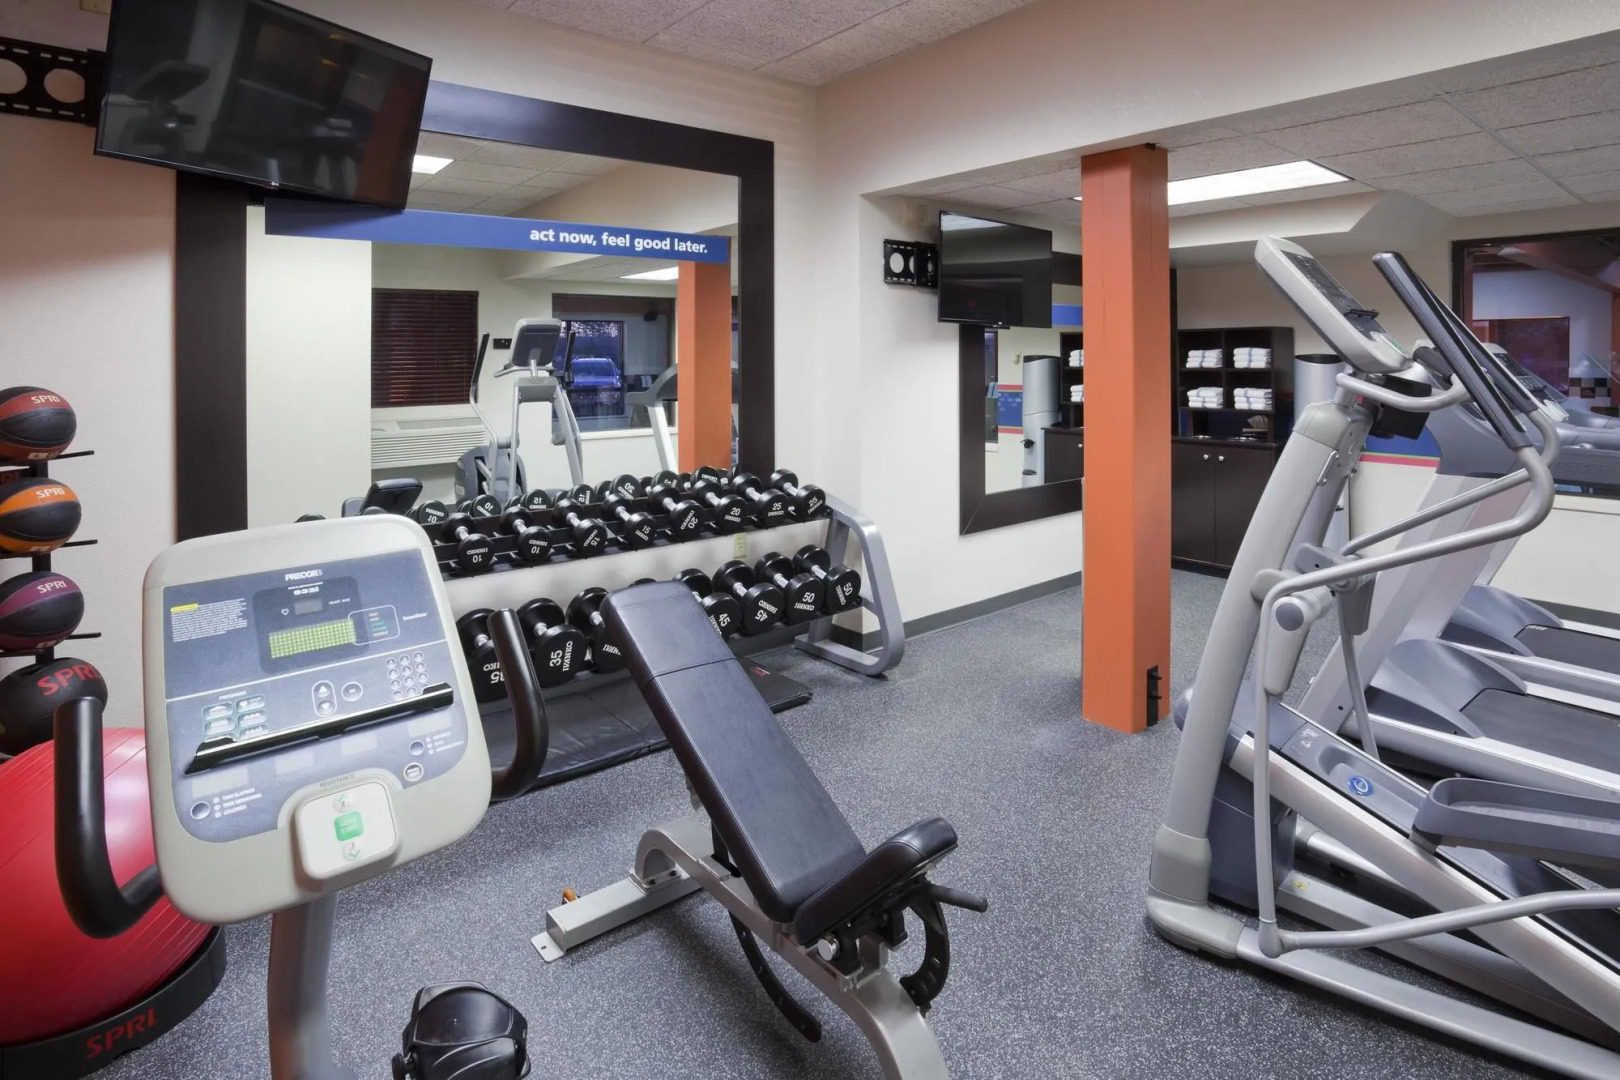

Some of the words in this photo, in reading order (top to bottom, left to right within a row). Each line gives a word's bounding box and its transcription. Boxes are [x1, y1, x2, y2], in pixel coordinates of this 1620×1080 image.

[530, 229, 555, 241] act
[559, 232, 597, 246] now,
[602, 232, 630, 247] feel
[634, 236, 670, 251] good
[674, 239, 708, 253] later.
[31, 395, 61, 404] SPRI
[36, 487, 66, 498] SPRI
[772, 502, 782, 511] 25
[808, 497, 818, 507] 25
[730, 507, 741, 516] 20
[687, 518, 698, 529] 20
[642, 525, 651, 534] 15
[590, 537, 600, 547] 15
[531, 546, 540, 554] 10
[472, 555, 482, 563] 10
[285, 570, 318, 581] PRECOR
[37, 580, 67, 594] SPRI
[843, 582, 853, 596] 50
[802, 592, 815, 603] 50
[758, 600, 778, 614] IVANKO
[718, 613, 731, 627] 45
[755, 610, 768, 622] 45
[550, 650, 563, 667] 35
[562, 640, 573, 672] IVANKO
[85, 1007, 159, 1058] SPRI
